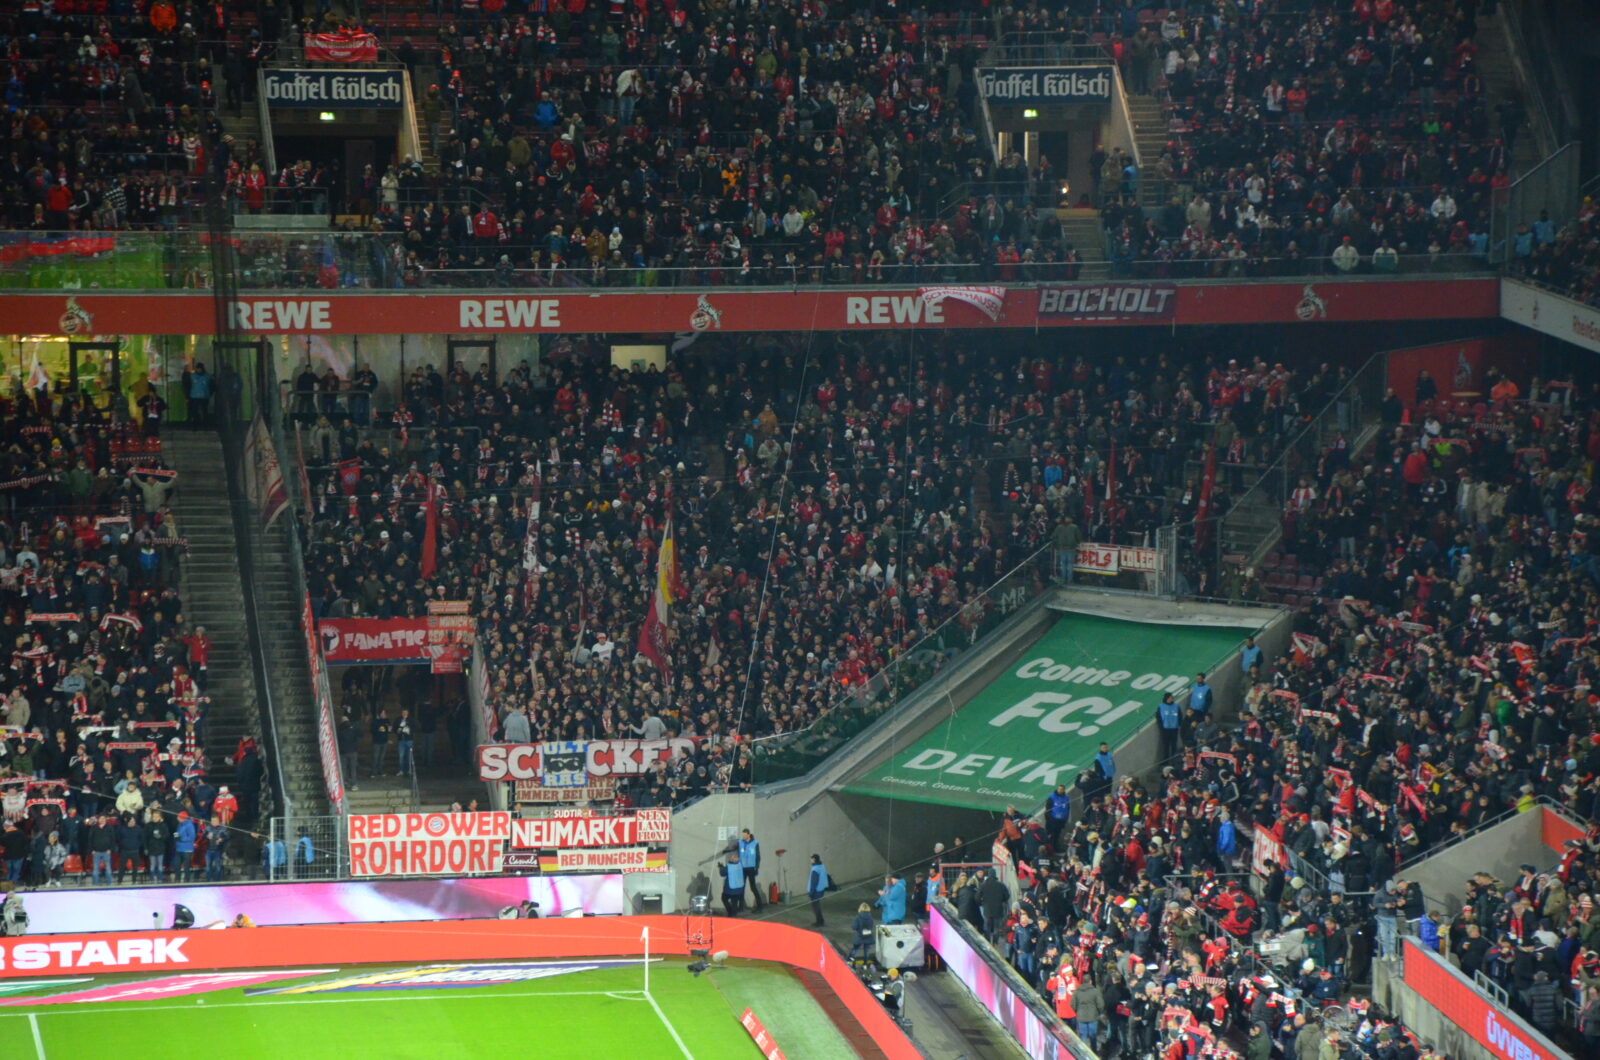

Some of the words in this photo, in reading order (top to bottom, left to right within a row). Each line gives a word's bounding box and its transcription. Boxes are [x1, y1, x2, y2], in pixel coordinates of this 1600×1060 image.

[266, 72, 328, 101] Gaffel
[332, 76, 400, 102] Kölsch
[981, 72, 1040, 99] Gaffel
[1043, 72, 1110, 98] Kölsch
[459, 300, 561, 328] REWE
[846, 296, 945, 324] REWE
[1038, 288, 1176, 313] BOCHOLT
[228, 301, 332, 329] REWE
[1016, 657, 1132, 687] Come
[988, 691, 1143, 737] FC!
[902, 748, 1080, 786] DEVK
[516, 789, 559, 801] IMMER
[562, 789, 583, 800] BEI
[586, 788, 612, 799] UNS
[349, 814, 401, 840] RED
[406, 812, 509, 838] POWER
[637, 810, 668, 820] SEEN
[637, 820, 669, 831] LAND
[511, 816, 636, 847] NEUMARKT
[350, 839, 502, 875] ROHRDORF
[560, 853, 584, 867] RED
[12, 937, 189, 970] STARK
